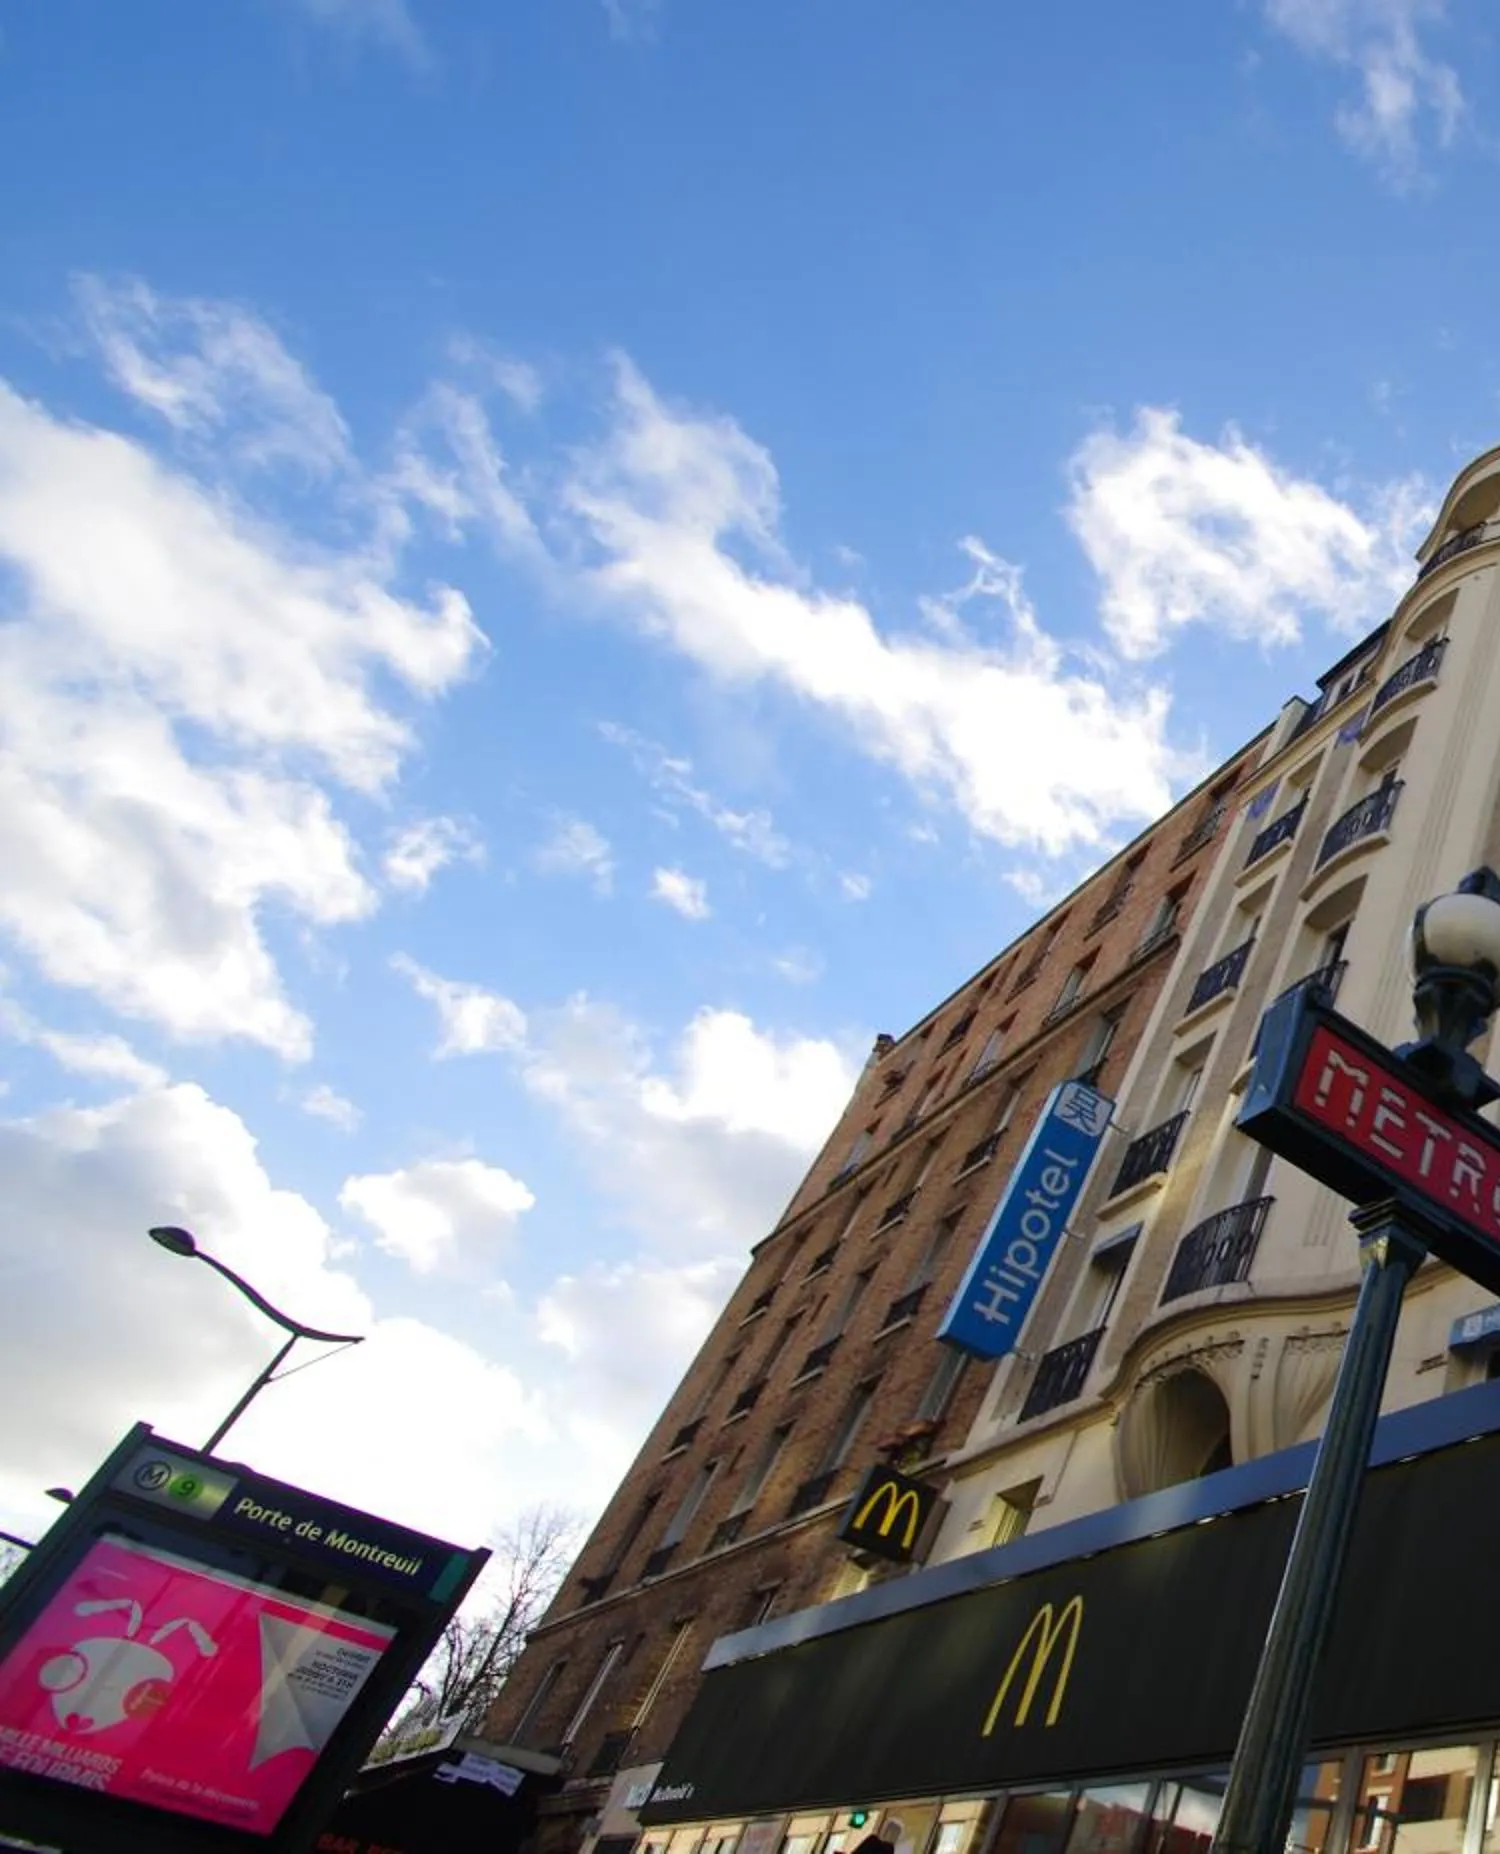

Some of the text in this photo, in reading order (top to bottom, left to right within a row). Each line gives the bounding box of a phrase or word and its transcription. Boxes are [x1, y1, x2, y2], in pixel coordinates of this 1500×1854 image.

[972, 1148, 1080, 1326] Hipotel
[179, 1478, 196, 1497] 9
[233, 1497, 423, 1577] Porte de Montreuil
